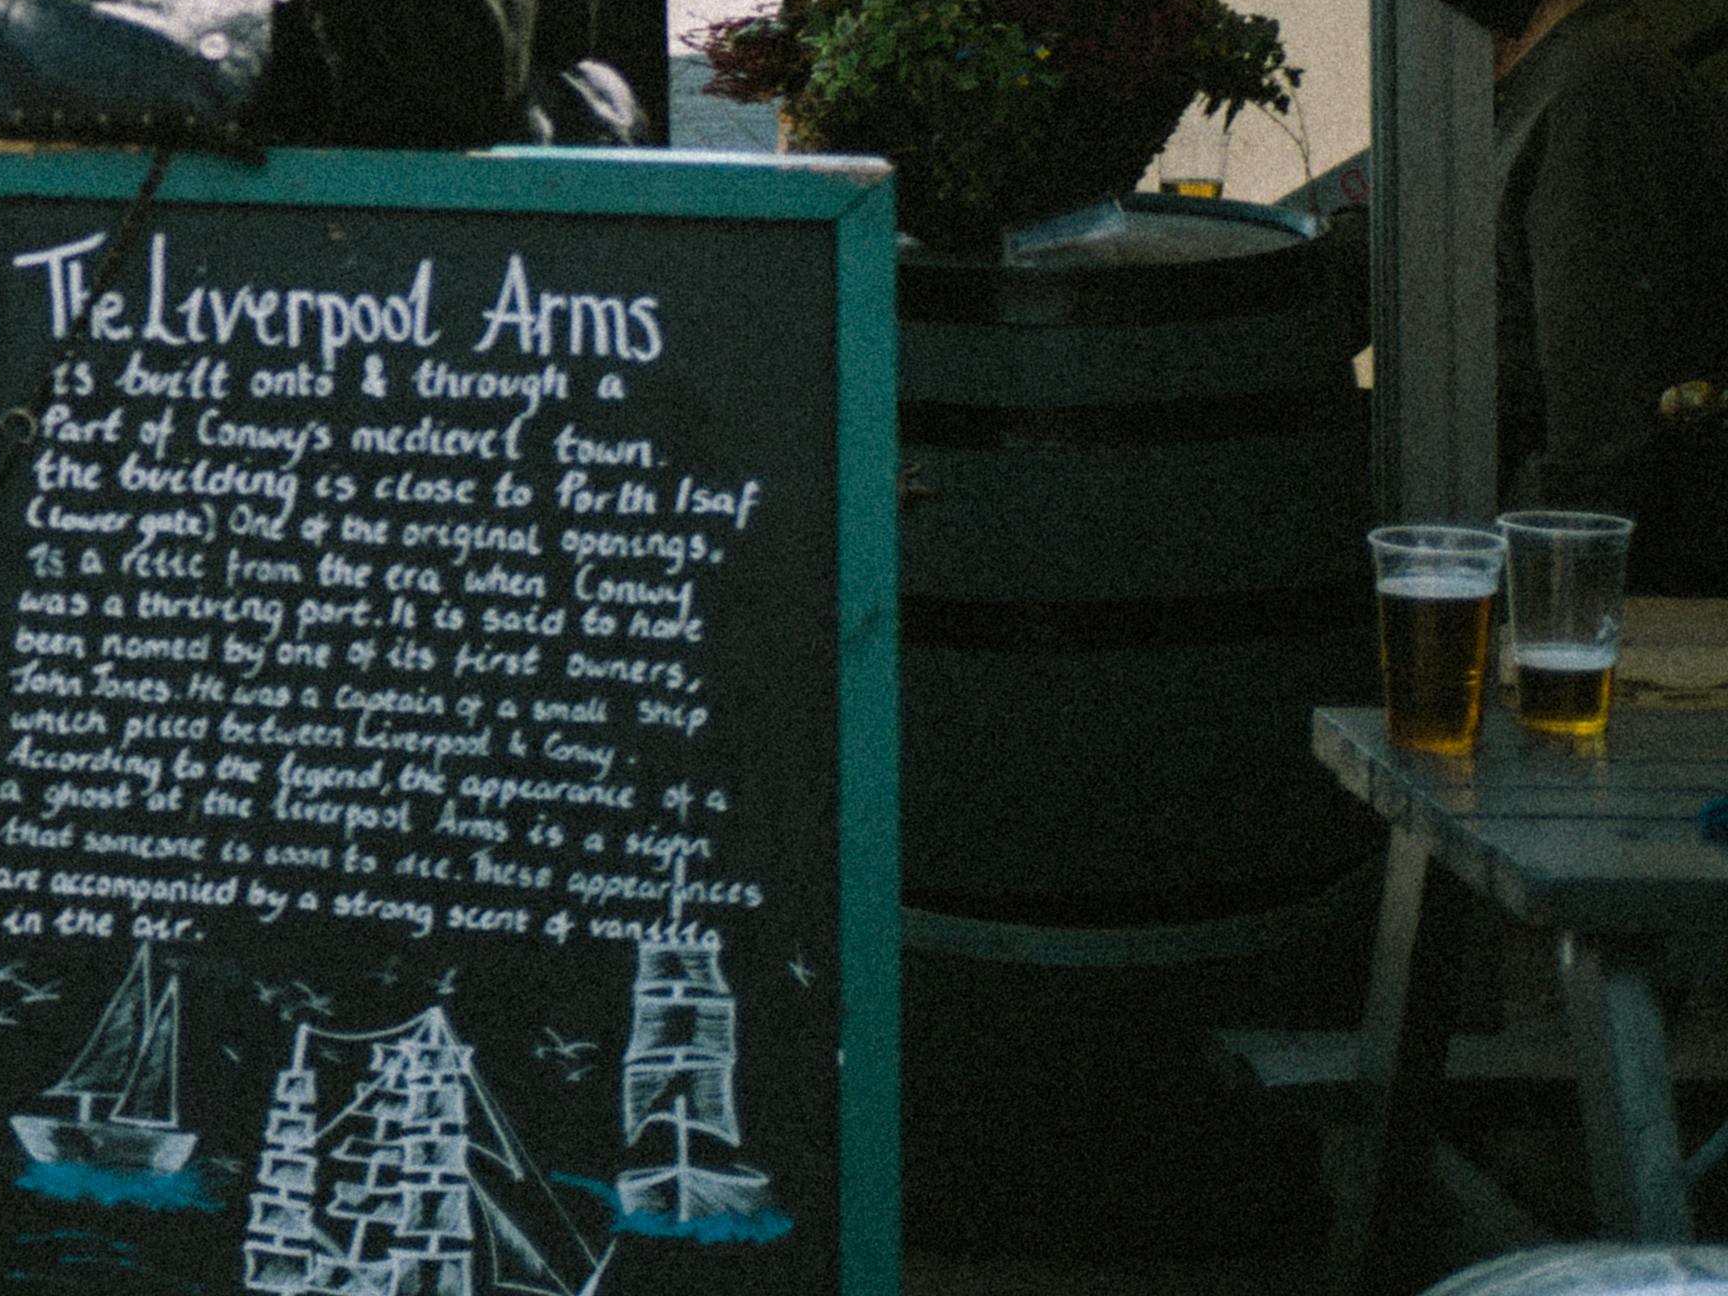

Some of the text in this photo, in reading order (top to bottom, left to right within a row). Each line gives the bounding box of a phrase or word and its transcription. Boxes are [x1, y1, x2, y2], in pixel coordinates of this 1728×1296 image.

[12, 231, 663, 371] The Liverpool Arms
[52, 350, 625, 416] is built onto & through a
[139, 406, 175, 460] of
[197, 408, 333, 470] Conwy's
[553, 423, 669, 468] town.
[34, 448, 760, 530] the building is close to Porth Isaf
[25, 496, 724, 576] (lower gate) One of the original openings.
[18, 590, 89, 617] was
[103, 594, 124, 618] a
[136, 589, 283, 643] thriving
[390, 595, 416, 629] It
[434, 600, 466, 632] is
[482, 605, 565, 637] said
[581, 606, 618, 638] to
[628, 609, 703, 643] have
[78, 548, 104, 576] a
[120, 549, 205, 579] relic
[226, 547, 301, 588] from
[316, 552, 372, 588] the
[384, 564, 441, 594] era
[463, 562, 545, 598] when
[574, 564, 693, 625] Conwy
[14, 625, 85, 659] been
[222, 632, 267, 679] by
[275, 643, 331, 669] one
[346, 639, 377, 672] of
[386, 637, 437, 672] its
[454, 642, 542, 678] first
[10, 659, 83, 696] John
[91, 660, 182, 704] Jones.
[187, 673, 225, 702] He
[231, 683, 291, 707] was
[300, 687, 320, 709] a
[456, 695, 484, 727] of
[497, 699, 518, 719] a
[532, 698, 607, 724] small
[10, 709, 107, 735] which
[122, 714, 210, 750] plied
[219, 712, 345, 748] between
[355, 711, 491, 771] Liverpool
[507, 730, 527, 758] &
[6, 735, 162, 795] According
[171, 747, 207, 780] to
[216, 753, 263, 785] the
[398, 762, 446, 794] the
[459, 775, 636, 812] appearance
[662, 781, 694, 822] of
[705, 789, 727, 812] a
[44, 780, 131, 819] ghost
[147, 786, 182, 812] at
[202, 787, 253, 819] the
[434, 799, 509, 842] Arms
[527, 813, 564, 847] is
[584, 833, 604, 853] a
[625, 825, 712, 871] sign
[83, 832, 206, 860] someone
[221, 838, 252, 863] is
[264, 841, 331, 869] soon
[343, 844, 378, 874] to
[470, 846, 553, 888] These
[567, 871, 764, 908] appearances
[2, 906, 44, 935] in
[52, 907, 114, 938] the
[50, 871, 239, 909] accompanied
[247, 879, 288, 922] by
[297, 892, 318, 910] a
[332, 890, 434, 938] strong
[447, 904, 530, 933] scent
[544, 911, 574, 944] of
[589, 917, 722, 952] vanilla
